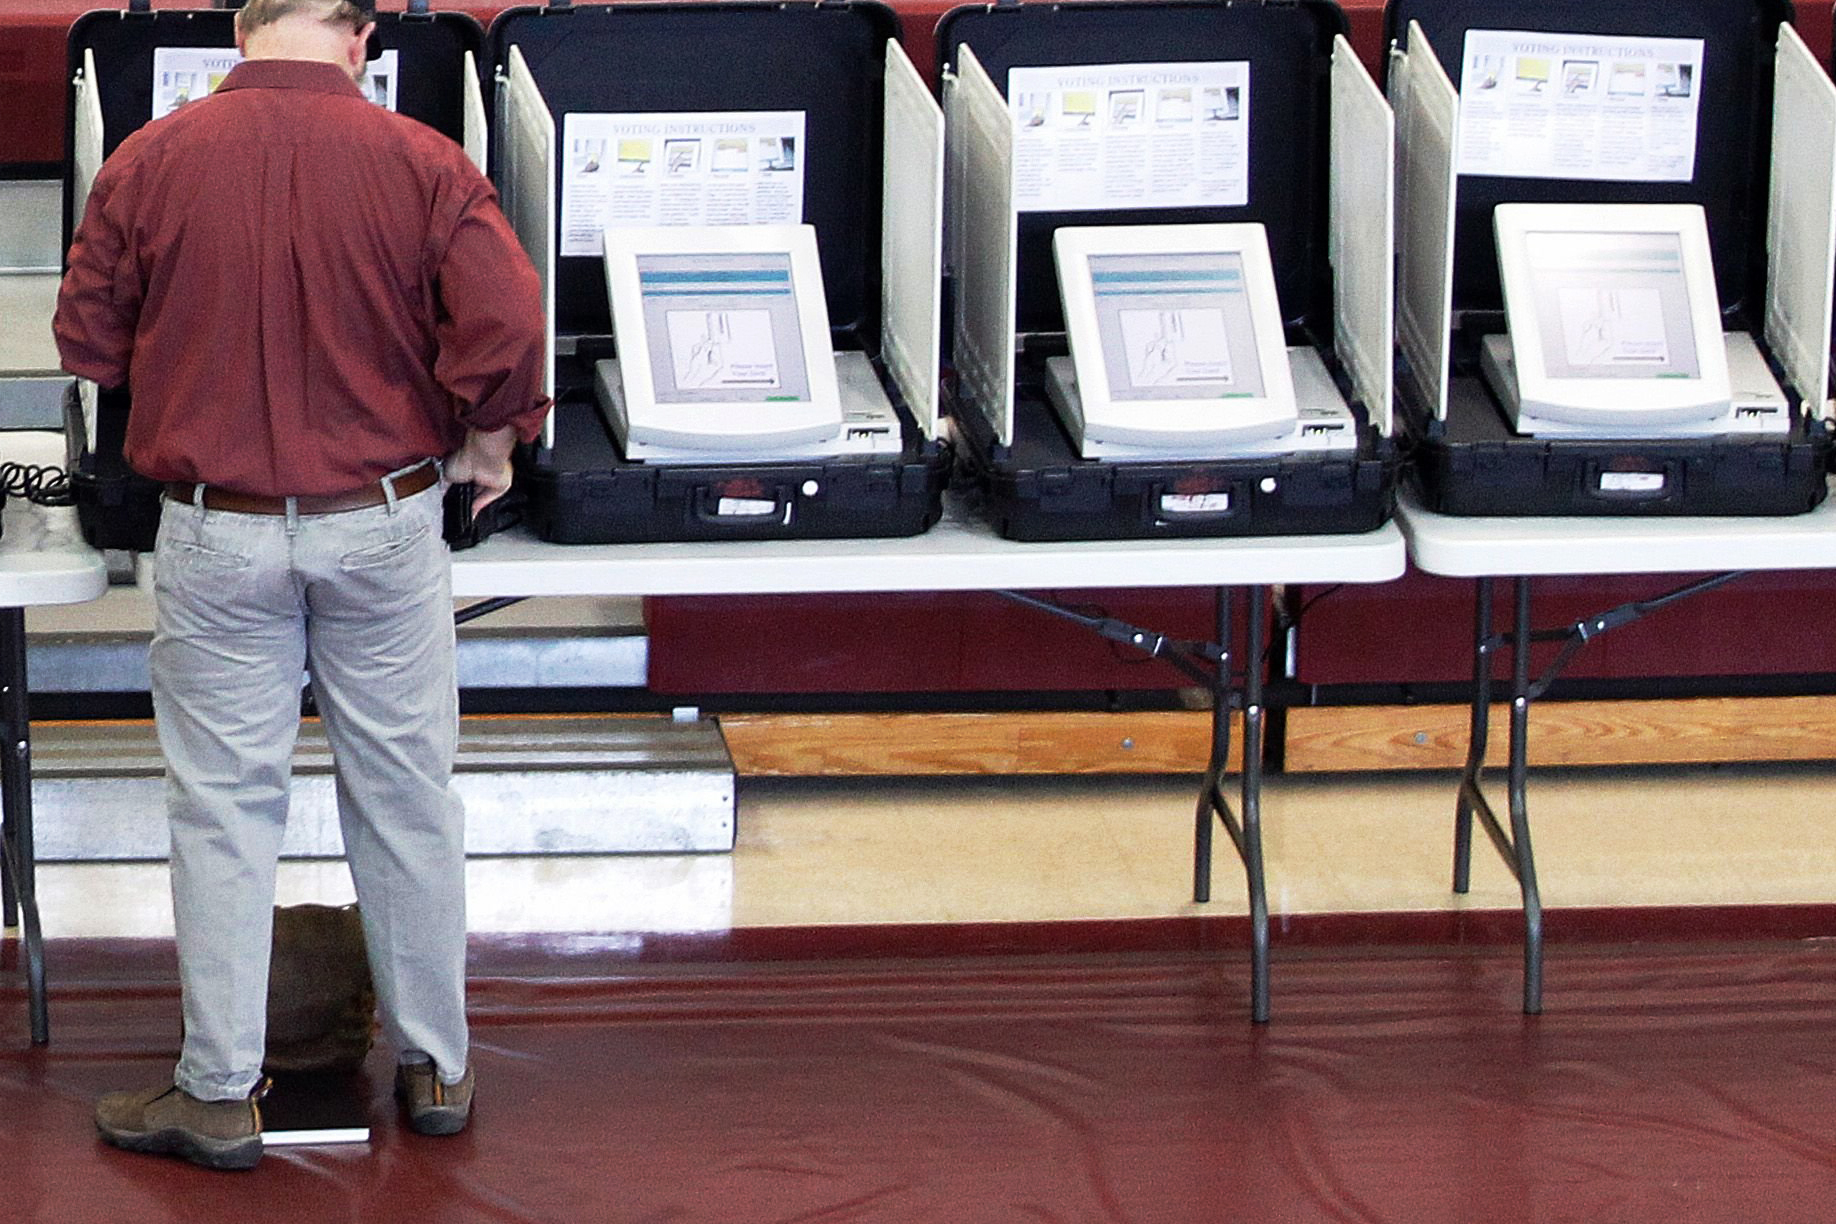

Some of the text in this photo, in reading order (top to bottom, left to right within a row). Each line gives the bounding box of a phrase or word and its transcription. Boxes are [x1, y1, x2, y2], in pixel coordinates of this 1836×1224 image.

[1512, 42, 1654, 56] VOTING INSTRUCTIONS
[1057, 73, 1200, 87] VOTING INSTRUCTIONS
[613, 123, 756, 134] VOTING INSTRUCTIONS
